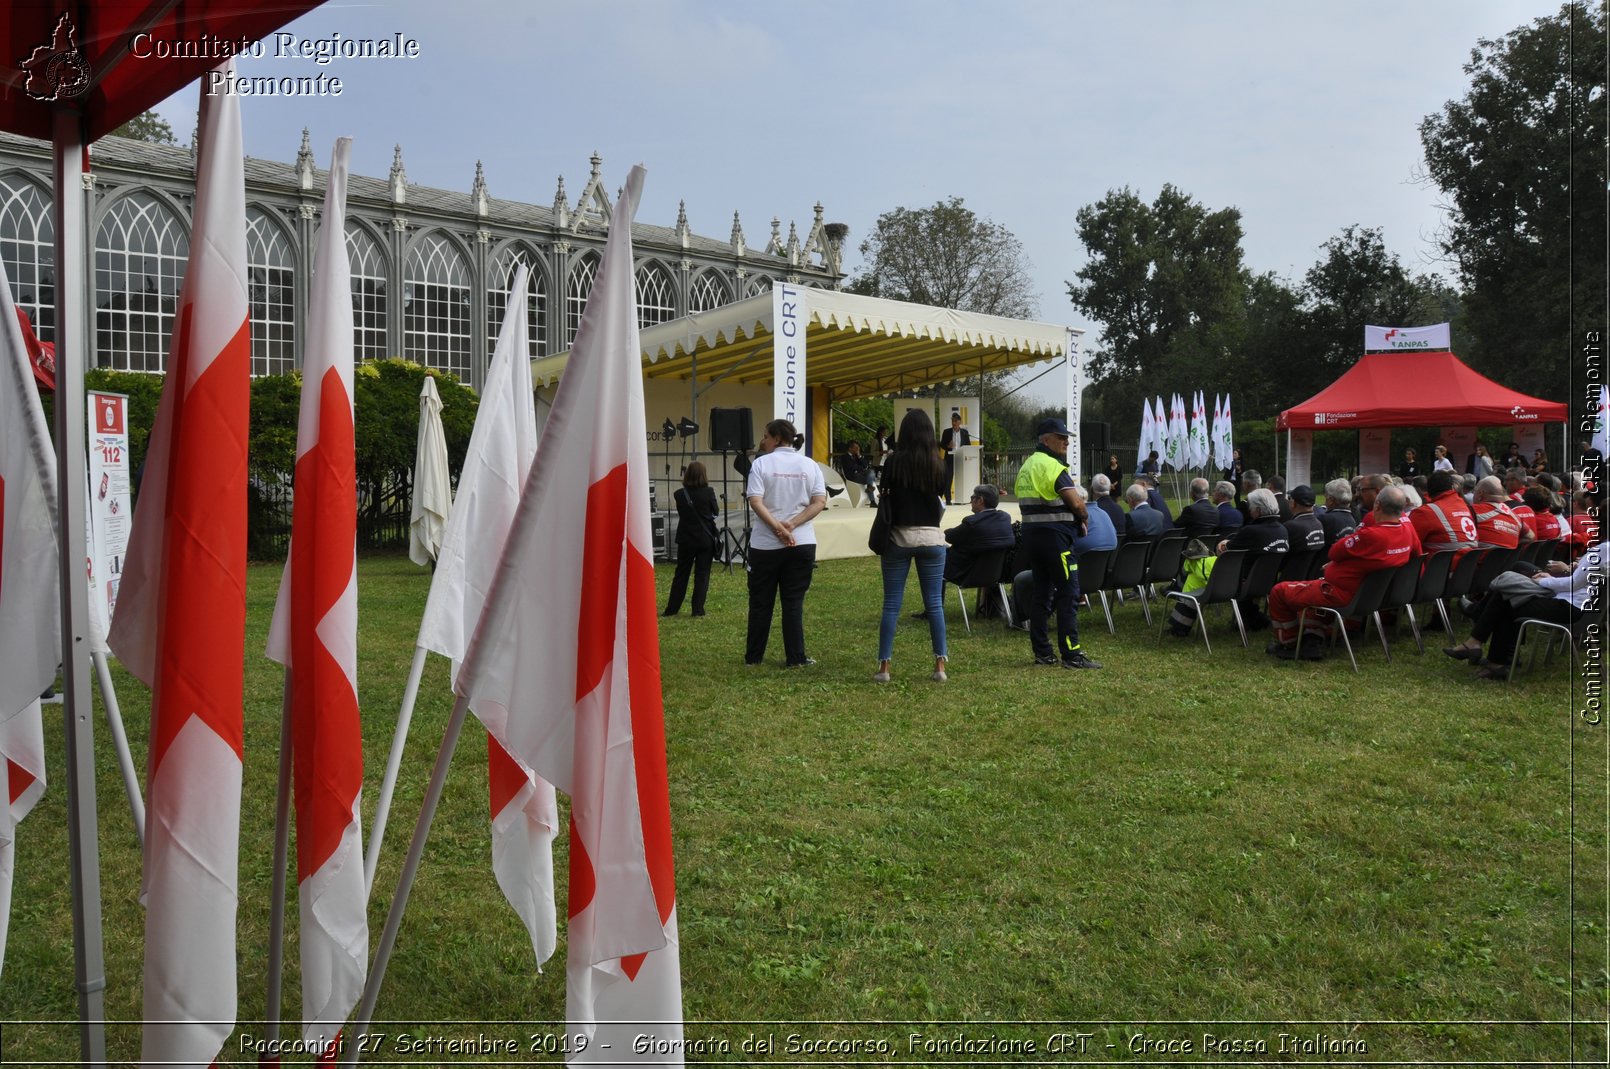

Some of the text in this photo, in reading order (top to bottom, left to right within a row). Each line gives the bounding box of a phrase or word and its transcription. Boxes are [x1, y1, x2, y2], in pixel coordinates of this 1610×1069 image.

[782, 284, 797, 338] CRT
[1070, 332, 1080, 368] CRT
[1397, 340, 1429, 348] ANPAS
[102, 446, 121, 463] 112
